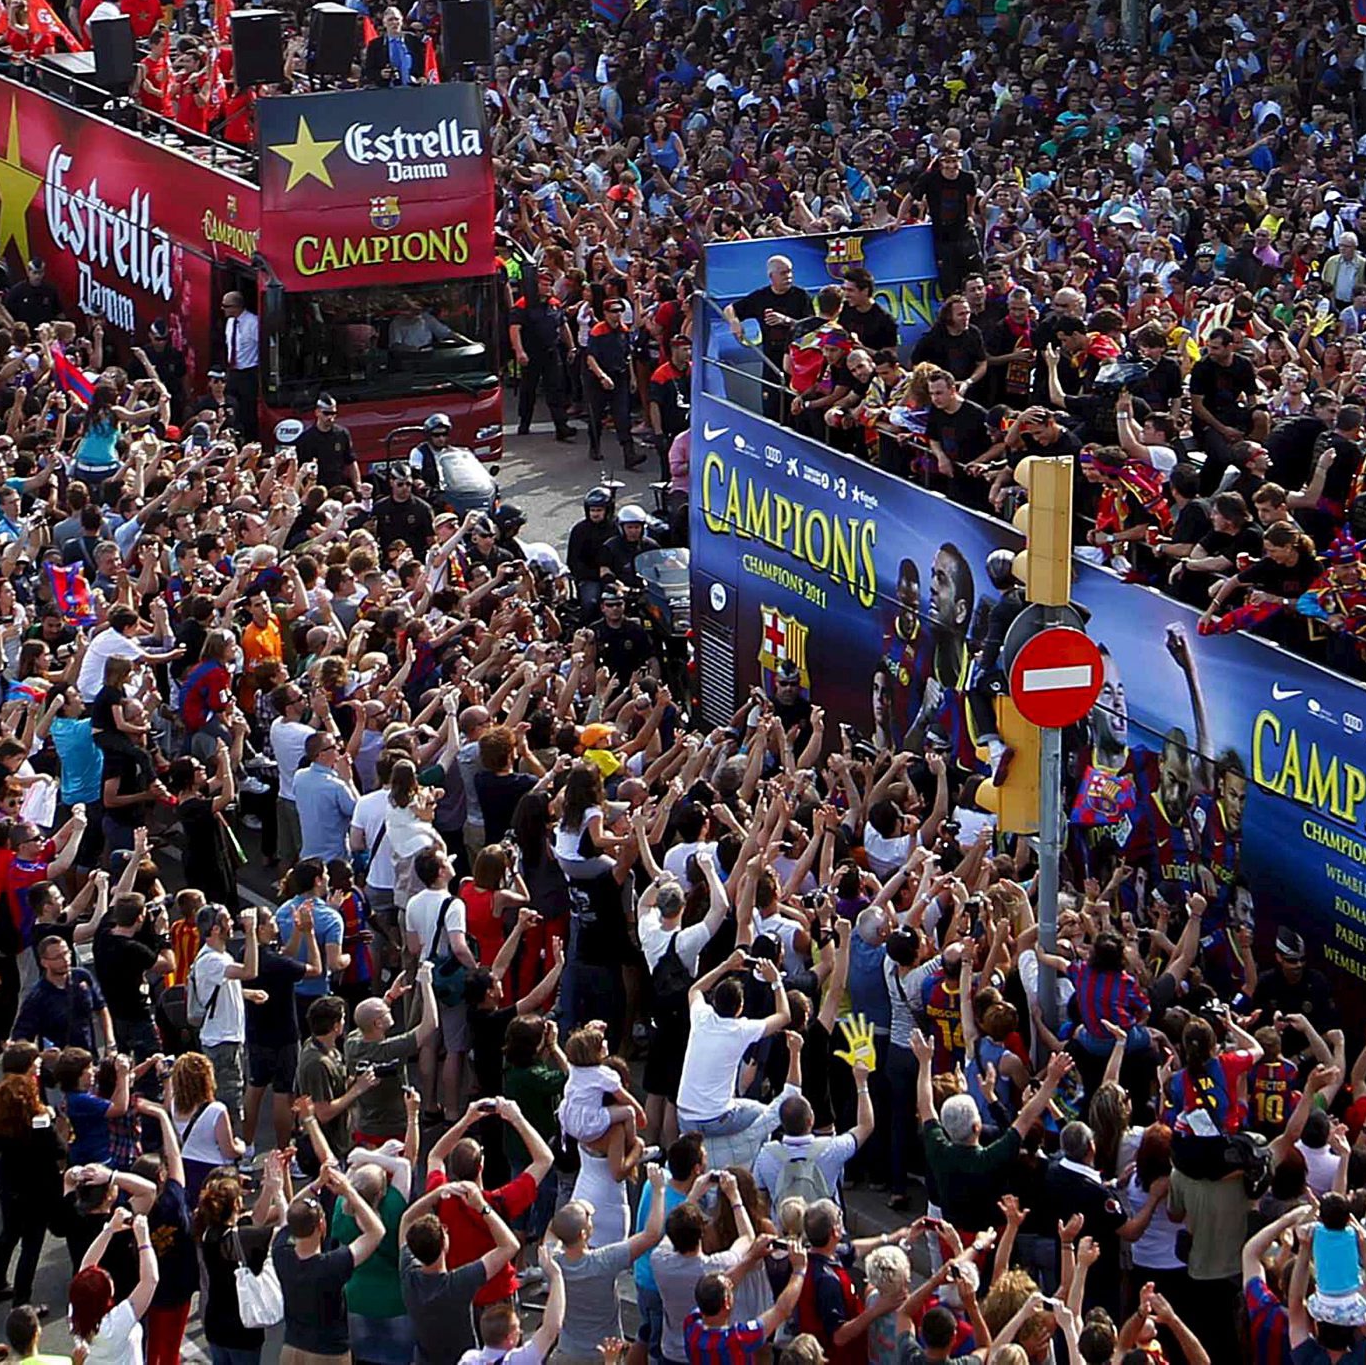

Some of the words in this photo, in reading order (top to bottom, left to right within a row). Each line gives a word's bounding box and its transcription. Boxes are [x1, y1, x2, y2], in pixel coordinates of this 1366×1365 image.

[343, 118, 484, 165] Estrella
[387, 161, 449, 184] Damm
[45, 143, 173, 302] Estrella
[294, 222, 469, 276] CAMPIONS
[78, 259, 135, 333] Damm
[702, 451, 877, 609] CAMPIONS
[743, 553, 803, 596] CHAMPIONS
[804, 578, 827, 610] 2011
[1255, 1092, 1285, 1124] 10
